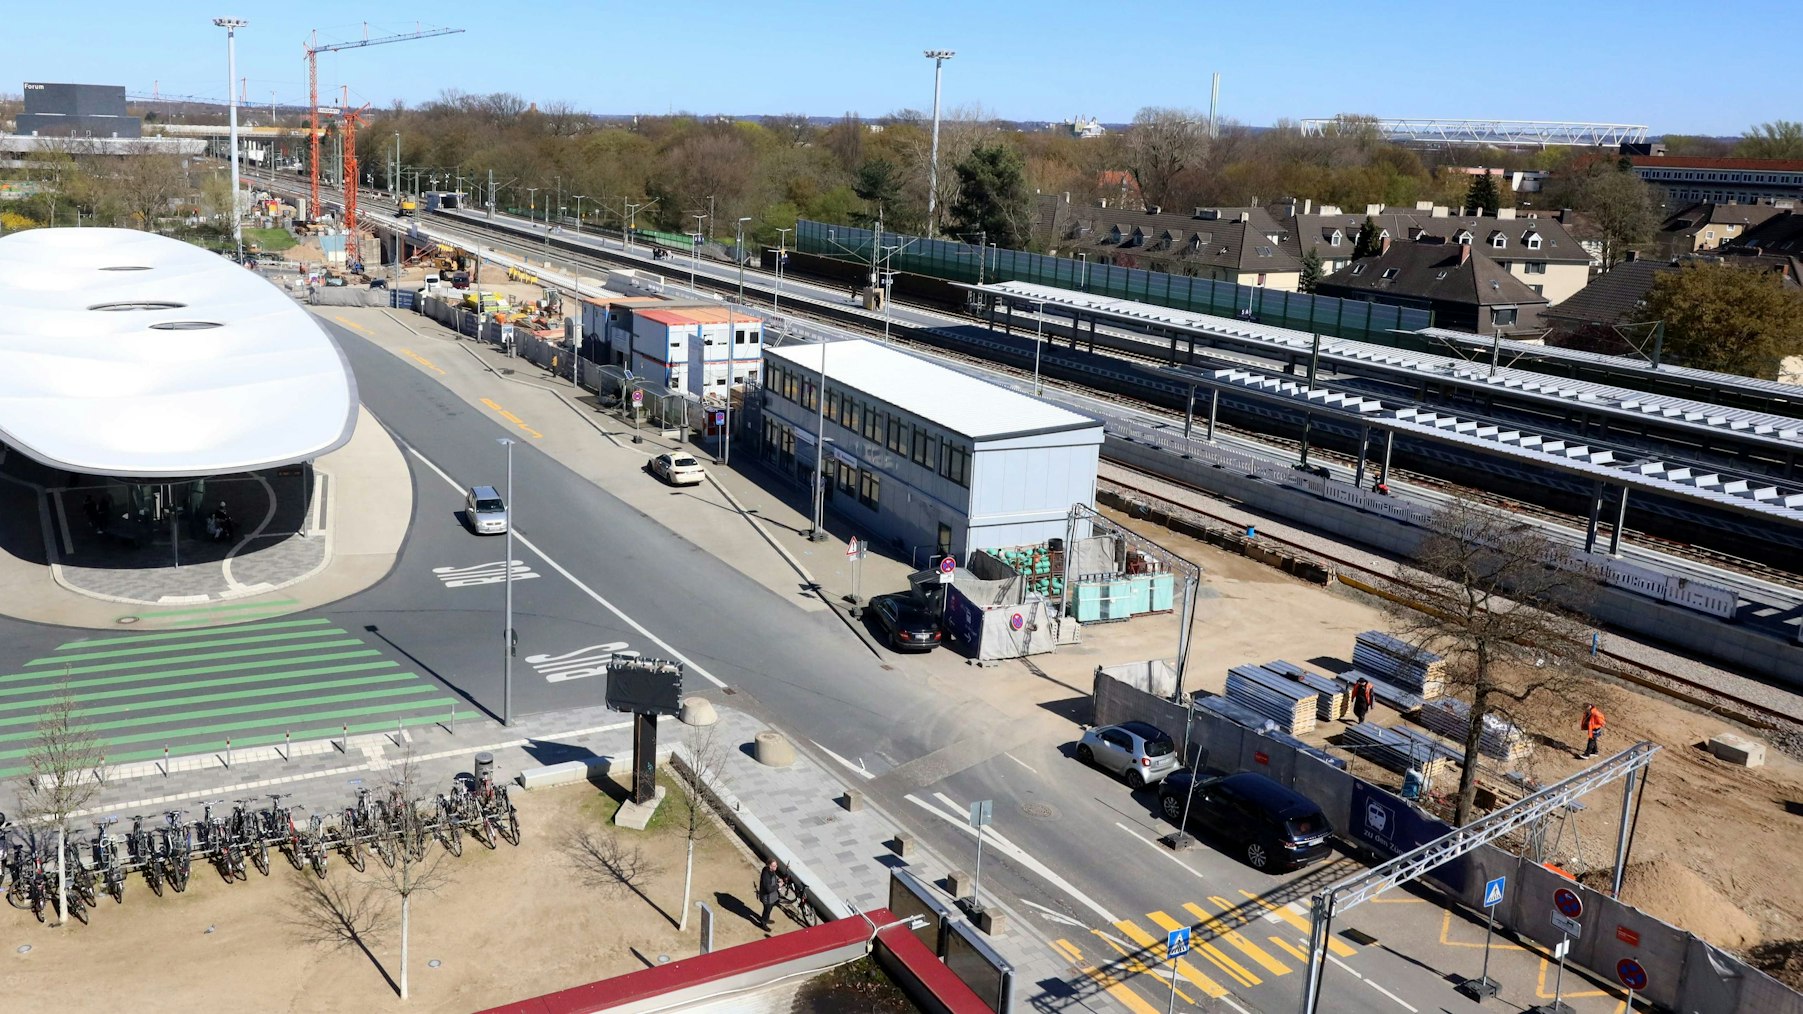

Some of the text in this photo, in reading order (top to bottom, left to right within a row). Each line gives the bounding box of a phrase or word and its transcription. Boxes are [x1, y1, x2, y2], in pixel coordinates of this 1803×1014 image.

[432, 560, 541, 588] BUS
[1363, 830, 1374, 839] zu
[1375, 834, 1389, 847] den
